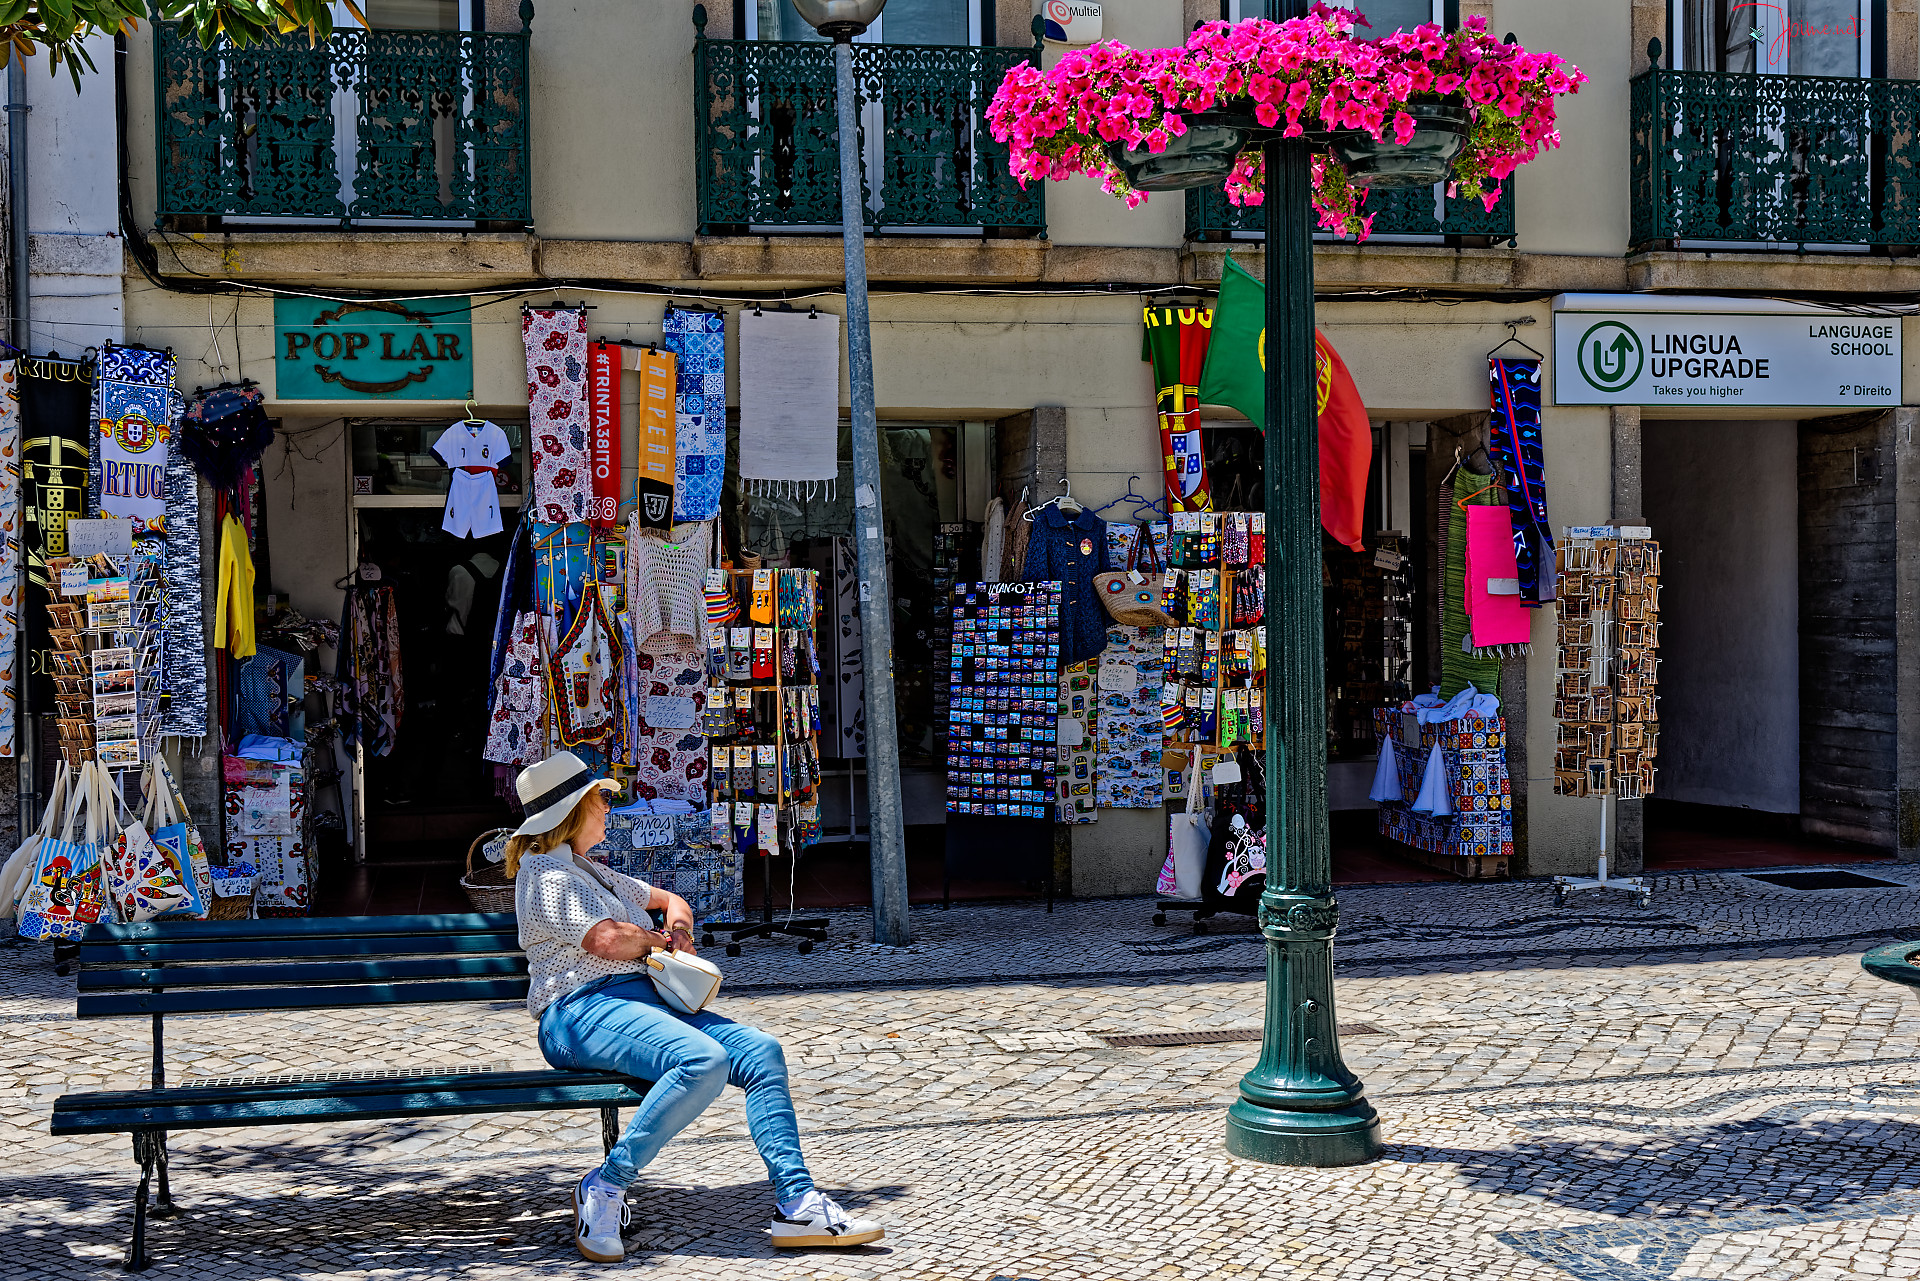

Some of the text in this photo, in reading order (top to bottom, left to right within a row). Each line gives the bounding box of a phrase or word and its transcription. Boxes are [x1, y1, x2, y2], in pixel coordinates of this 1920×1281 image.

[1069, 5, 1101, 17] Multiel
[1809, 325, 1893, 339] LANGUAGE
[284, 332, 463, 360] POP LAR
[1651, 334, 1743, 355] LINGUA
[1830, 342, 1894, 356] SCHOOL
[1651, 358, 1770, 379] UPGRADE
[1653, 385, 1744, 398] Takes you higher
[1839, 384, 1892, 396] 2º Direito
[1203, 711, 1213, 722] 7
[38, 911, 74, 922] PORTUGAL
